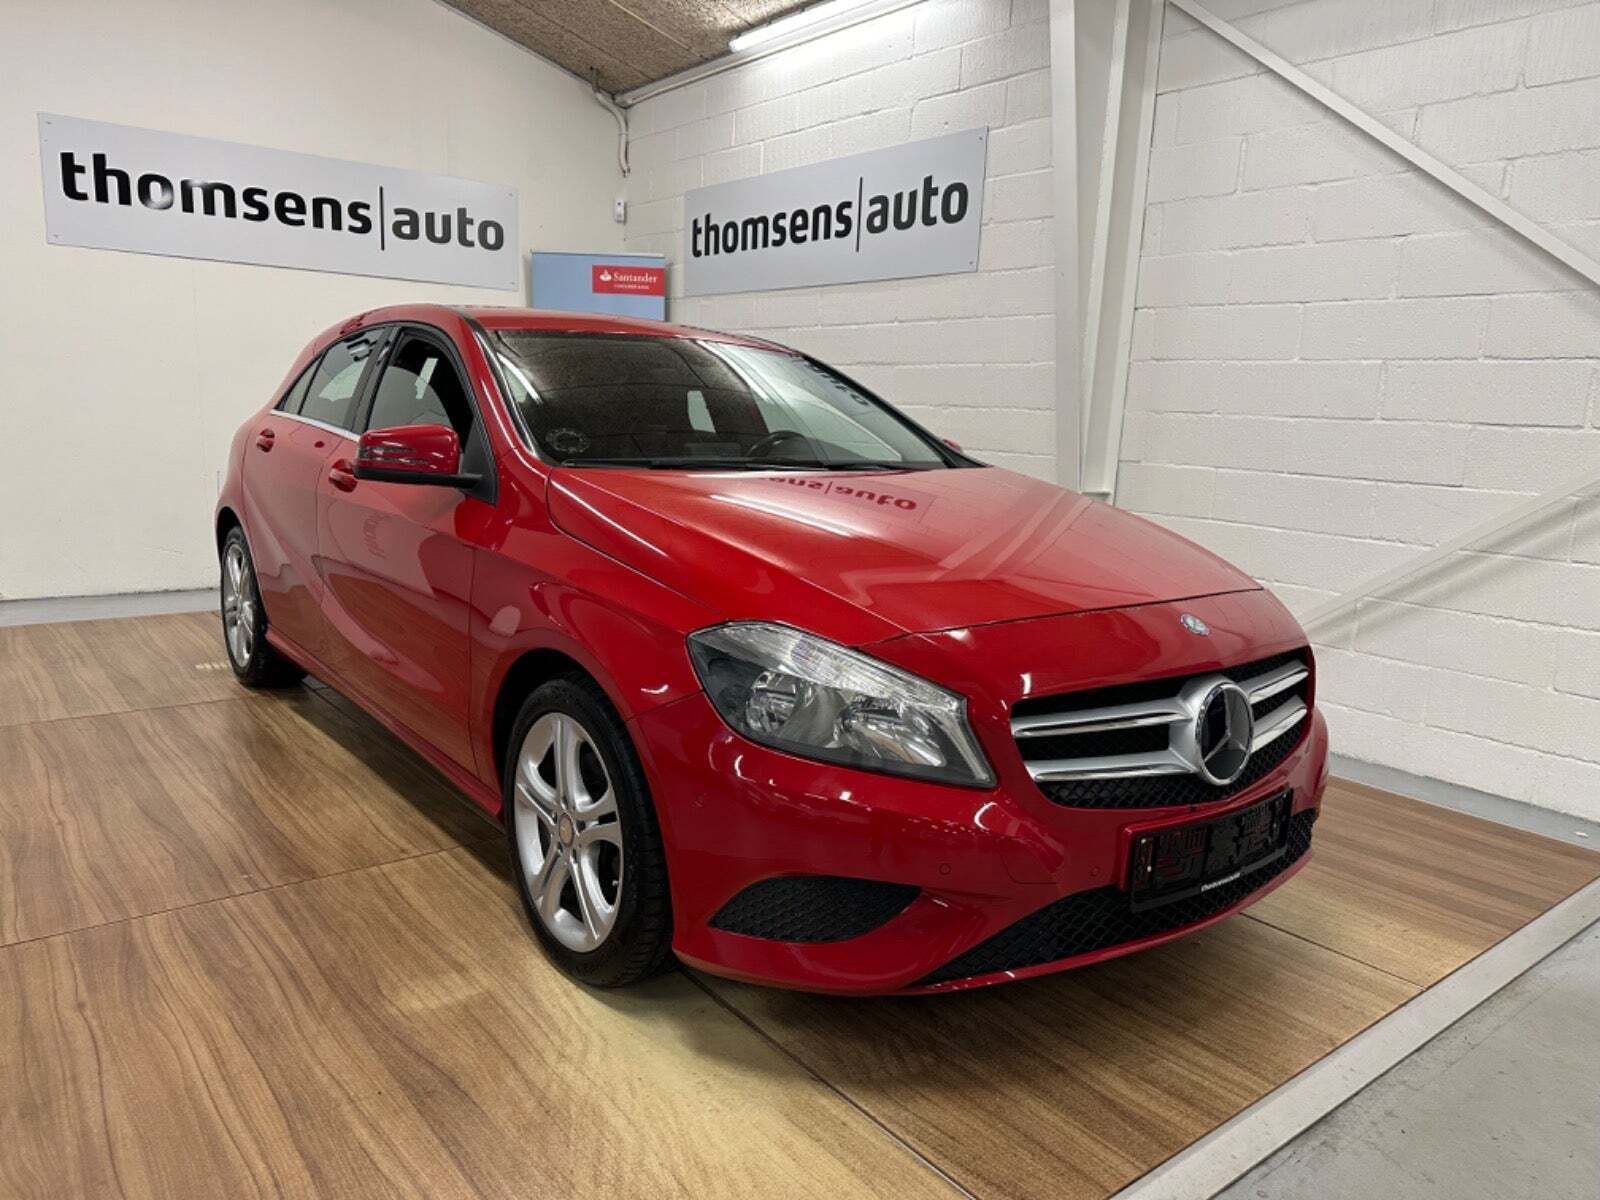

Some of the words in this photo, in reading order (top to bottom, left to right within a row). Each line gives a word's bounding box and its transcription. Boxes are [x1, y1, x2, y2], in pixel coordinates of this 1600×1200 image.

[60, 152, 373, 235] thomsens
[391, 207, 505, 251] auto
[691, 200, 854, 258] thomsens
[866, 175, 969, 234] auto
[613, 272, 657, 283] Santander
